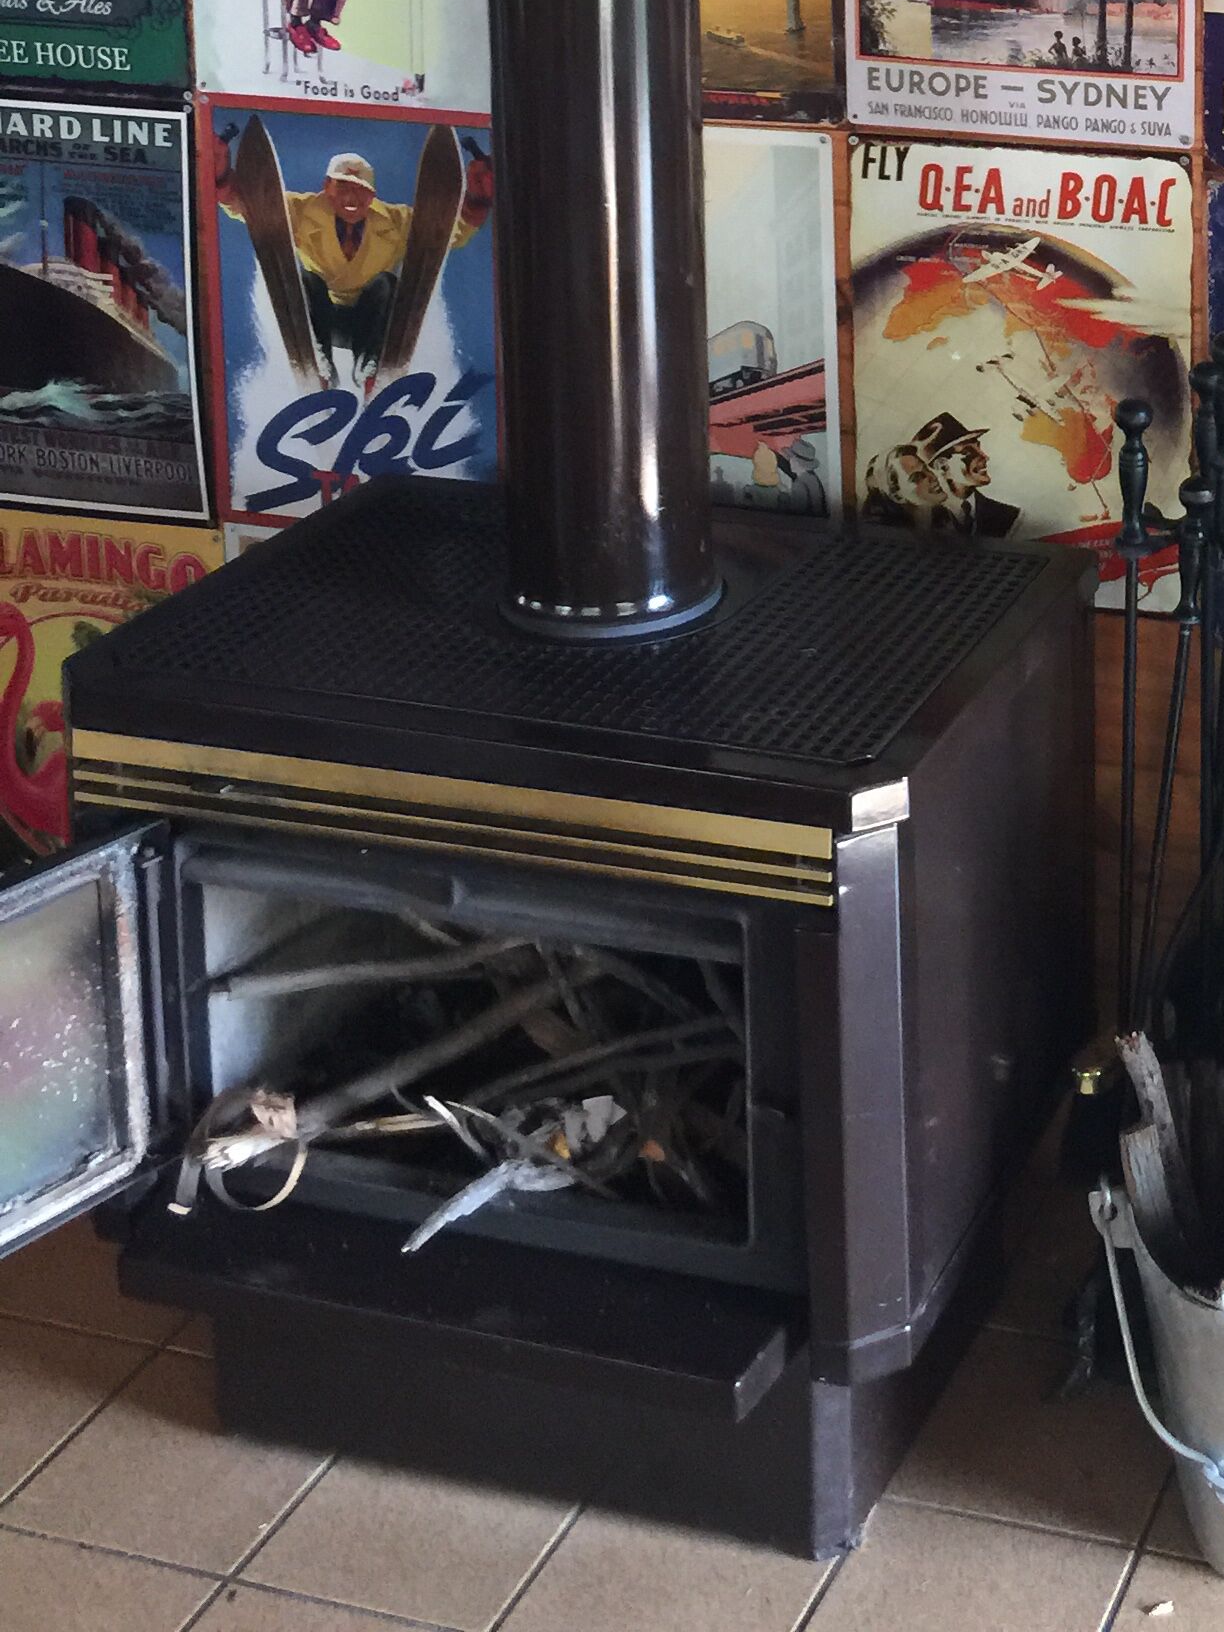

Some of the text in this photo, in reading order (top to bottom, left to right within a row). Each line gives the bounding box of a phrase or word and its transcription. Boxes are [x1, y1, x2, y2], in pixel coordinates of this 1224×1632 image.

[34, 41, 132, 71] HOUSE
[344, 84, 355, 99] is
[866, 65, 1173, 113] EUROPE SYDNEY
[92, 118, 173, 148] LINE
[866, 100, 1173, 139] SAN PANGO PANGO SUVA
[860, 141, 1052, 220] FLY and
[246, 371, 484, 513] Ski
[35, 447, 101, 474] BOSTON
